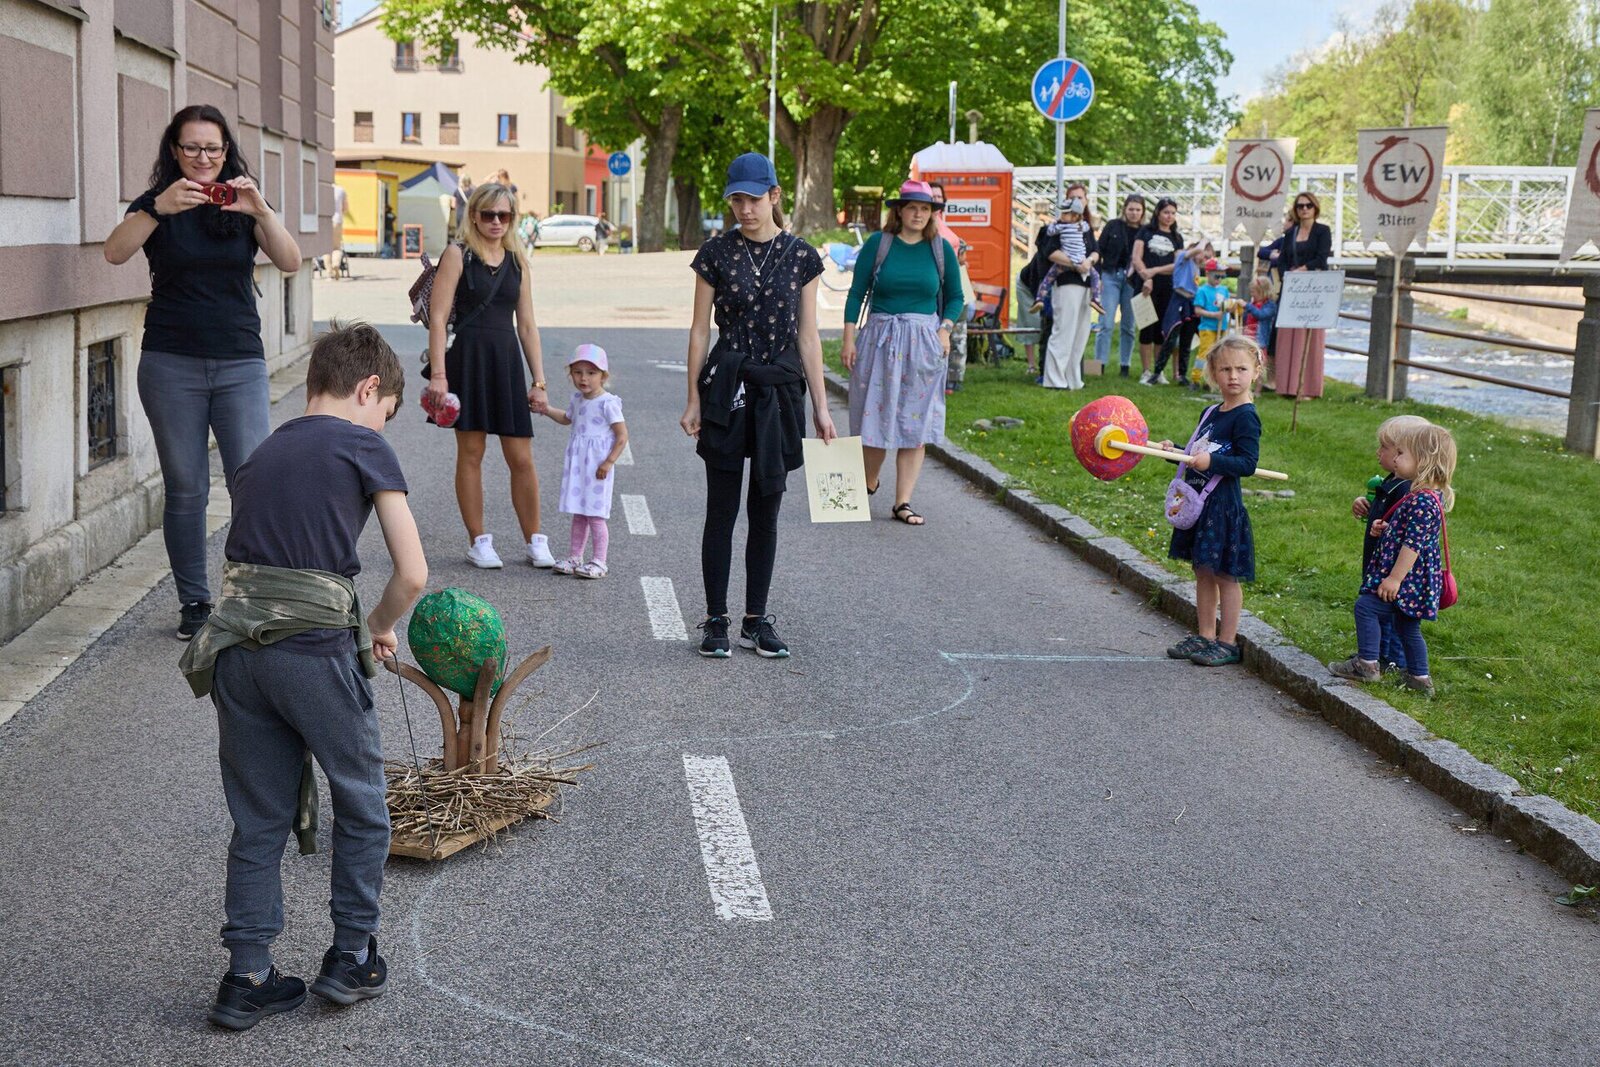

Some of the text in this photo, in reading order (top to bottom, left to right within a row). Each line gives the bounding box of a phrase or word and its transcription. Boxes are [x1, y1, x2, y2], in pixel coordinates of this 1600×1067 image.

[1242, 165, 1276, 182] SW
[1382, 163, 1426, 184] EW
[947, 204, 987, 214] Boels
